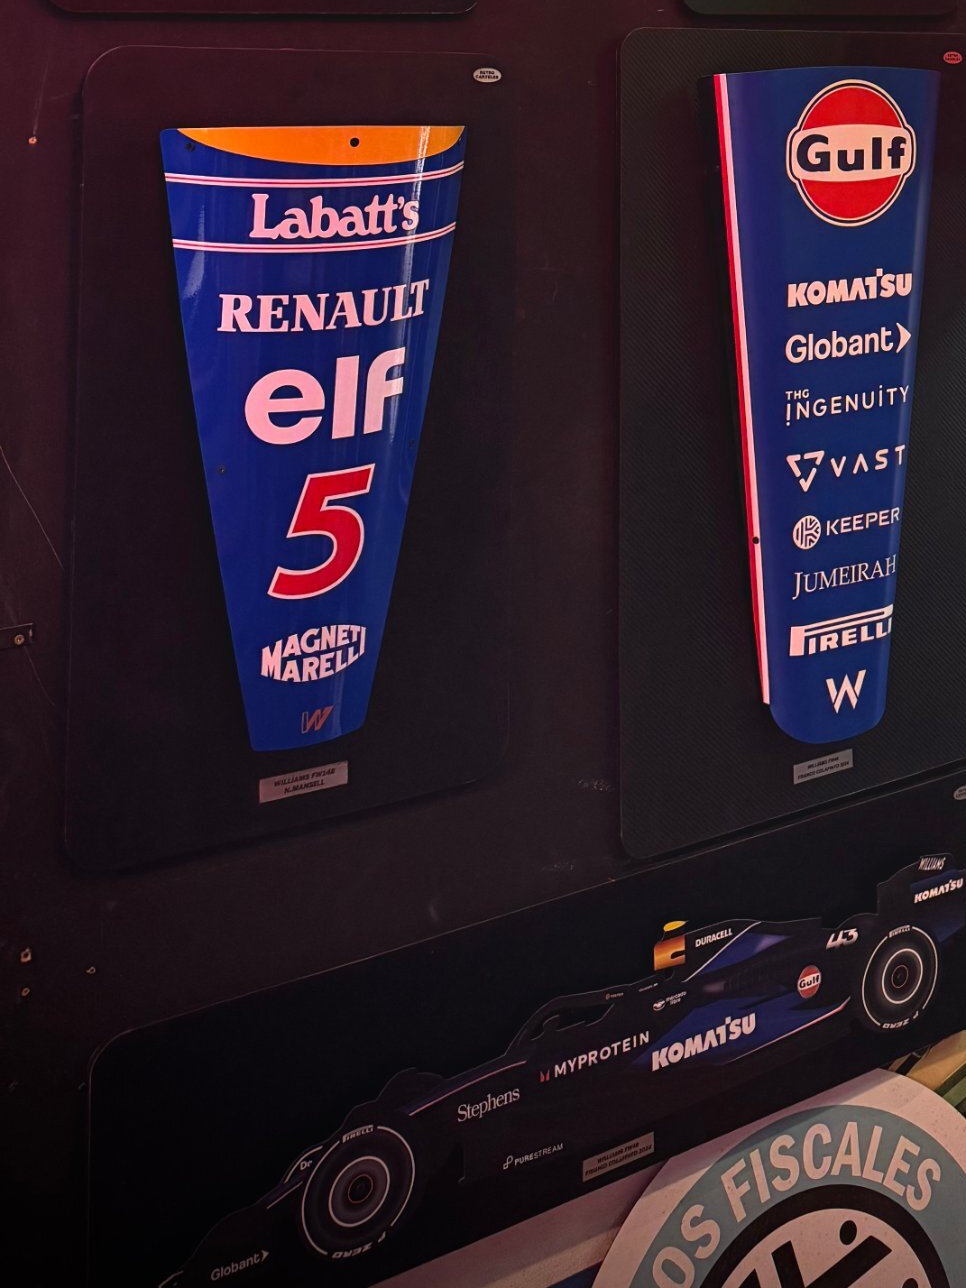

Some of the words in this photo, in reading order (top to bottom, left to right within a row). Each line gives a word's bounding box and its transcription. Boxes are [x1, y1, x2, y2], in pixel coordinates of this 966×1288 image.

[796, 133, 907, 172] Gulf
[249, 193, 420, 241] Labatt's
[216, 278, 430, 333] RENAULT
[787, 268, 913, 308] KOMATSU
[785, 327, 894, 364] Globant
[244, 346, 406, 445] elf
[785, 388, 810, 400] THG
[785, 384, 910, 427] INGENUITY
[830, 444, 906, 478] VAST
[267, 463, 376, 600] 5
[826, 507, 900, 537] KEEPER
[792, 553, 897, 601] JUMEIRAH
[261, 623, 367, 670] MAGNETI
[789, 603, 893, 657] PIRELLI
[261, 644, 366, 683] MARELLI
[273, 772, 309, 788] WILLIAMS
[918, 857, 946, 871] WILLIAMS
[914, 877, 964, 904] KOMATSU
[695, 928, 733, 948] DURACELL
[826, 928, 859, 950] 43
[799, 974, 820, 990] Gulf
[554, 1030, 650, 1078] MYPROTEIN
[651, 1013, 757, 1072] KOMATSU
[457, 1088, 521, 1123] Stephens
[342, 1124, 374, 1144] PIRELLI
[514, 1143, 564, 1167] PURESTREAM
[720, 1121, 942, 1223] FISCALES
[210, 1253, 260, 1282] Globant
